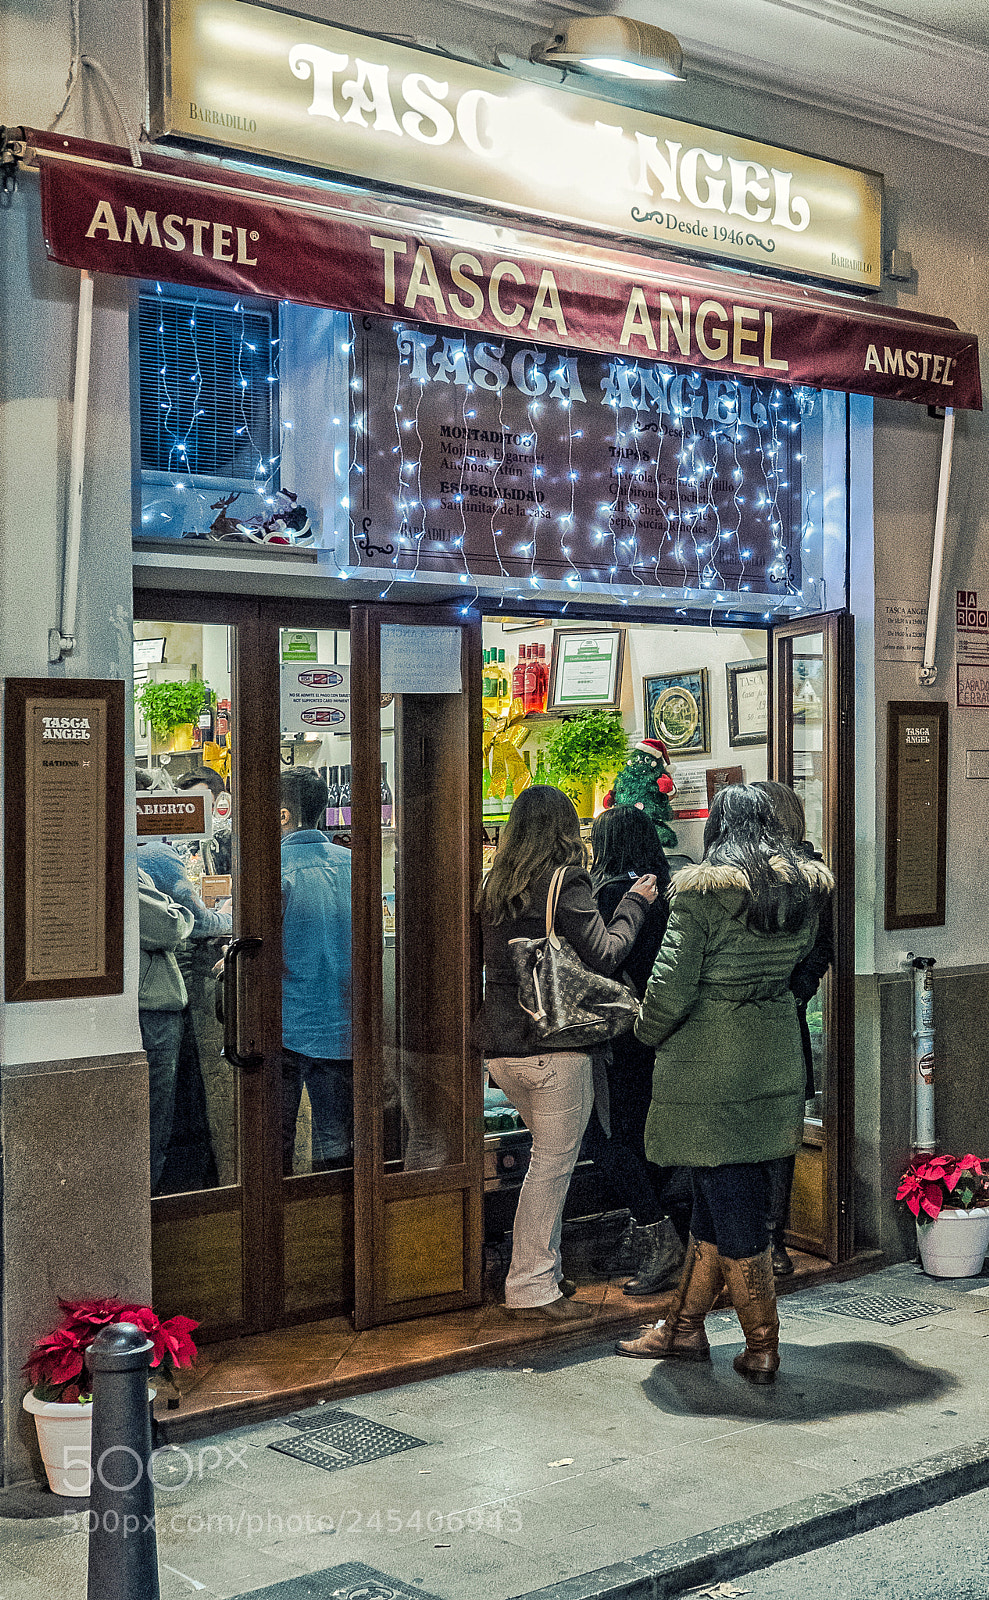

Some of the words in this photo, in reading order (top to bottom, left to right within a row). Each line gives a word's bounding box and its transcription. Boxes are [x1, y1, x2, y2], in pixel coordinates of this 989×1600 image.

[189, 102, 258, 133] BARBADILLO
[288, 43, 524, 158] TASC
[594, 120, 811, 232] NGEL
[665, 213, 709, 239] Desde
[712, 224, 745, 247] 1946
[830, 251, 873, 274] BARBADILLO
[370, 235, 568, 336] TASCA
[618, 287, 789, 371] ANGEL
[397, 330, 587, 403] TASCA
[600, 362, 768, 428] ANGEL
[501, 503, 514, 515] de
[516, 505, 526, 517] la
[957, 591, 977, 608] LA
[957, 610, 989, 627] ROO
[42, 717, 90, 728] TASCA
[42, 729, 90, 740] ANGEL
[905, 727, 930, 736] TASCA
[905, 736, 930, 744] ANGEL
[136, 803, 196, 815] ABIERTO
